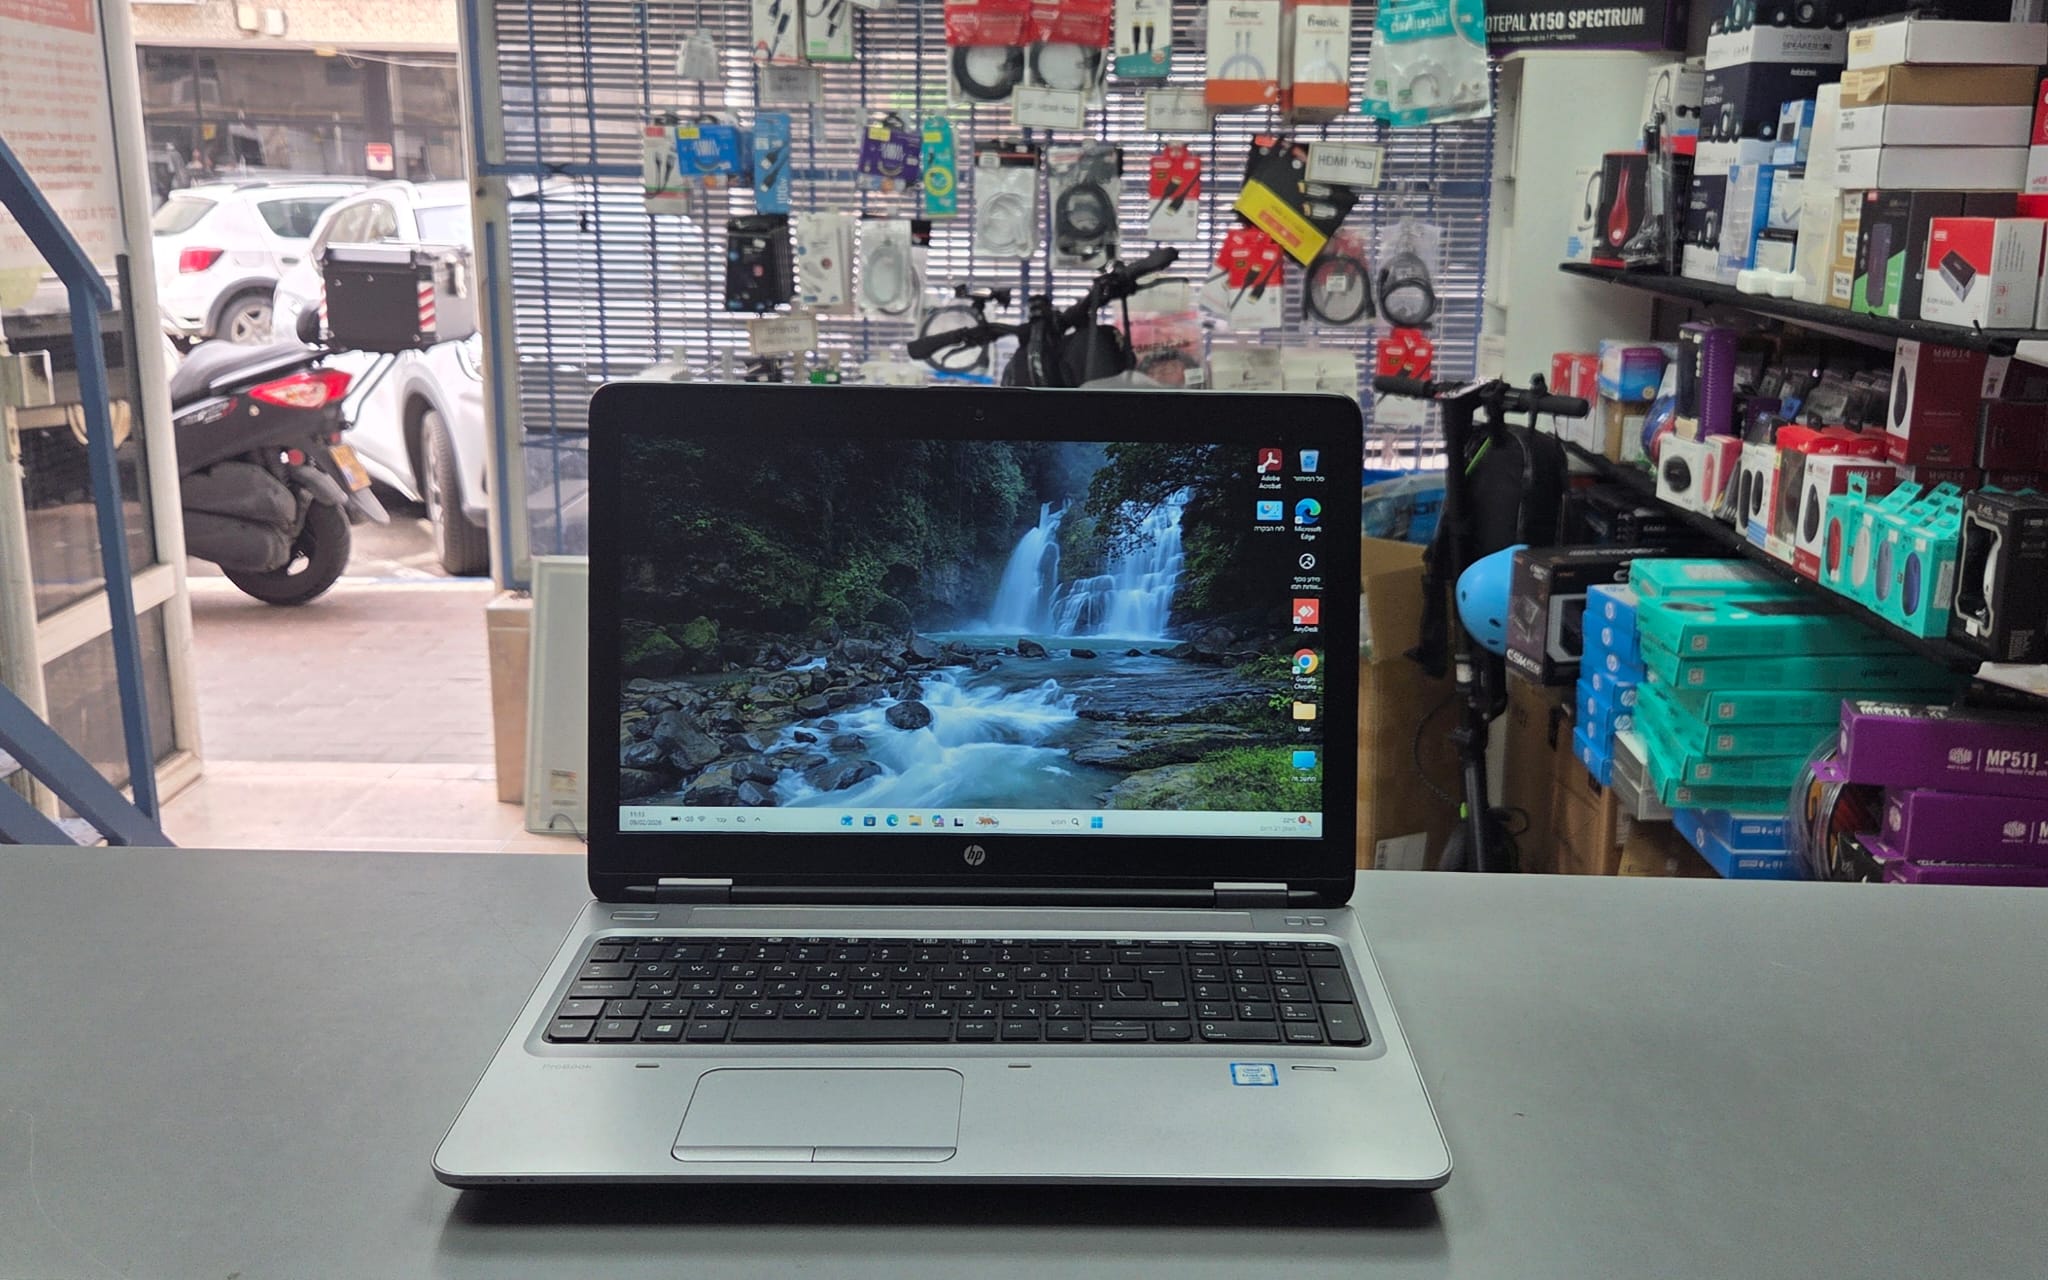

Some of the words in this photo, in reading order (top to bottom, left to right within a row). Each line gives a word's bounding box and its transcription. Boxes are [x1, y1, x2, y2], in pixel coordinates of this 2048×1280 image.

[1485, 14, 1527, 33] OTEPAL
[1529, 11, 1564, 31] X150
[1567, 7, 1645, 29] SPECTRUM
[1317, 153, 1348, 167] HDMI
[1986, 749, 2038, 768] MP511
[963, 844, 985, 866] hp
